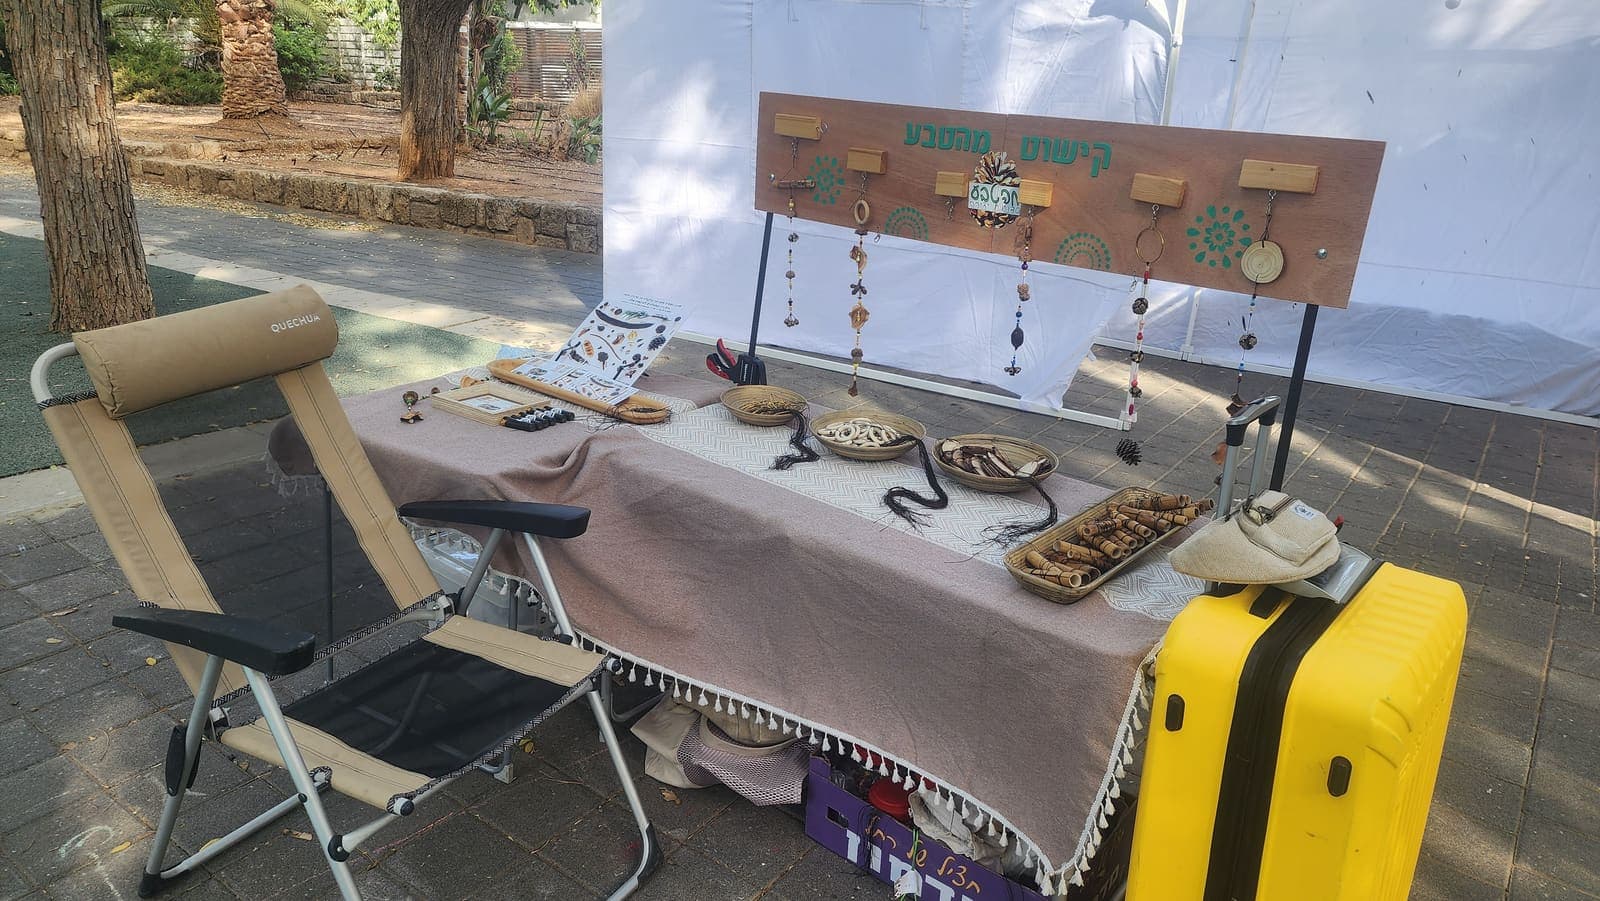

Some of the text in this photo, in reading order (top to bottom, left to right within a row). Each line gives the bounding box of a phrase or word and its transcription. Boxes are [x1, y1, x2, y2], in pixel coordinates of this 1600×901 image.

[904, 122, 1112, 177] קישוט מהטבע
[270, 313, 321, 334] QUECHUA
[906, 839, 928, 867] של
